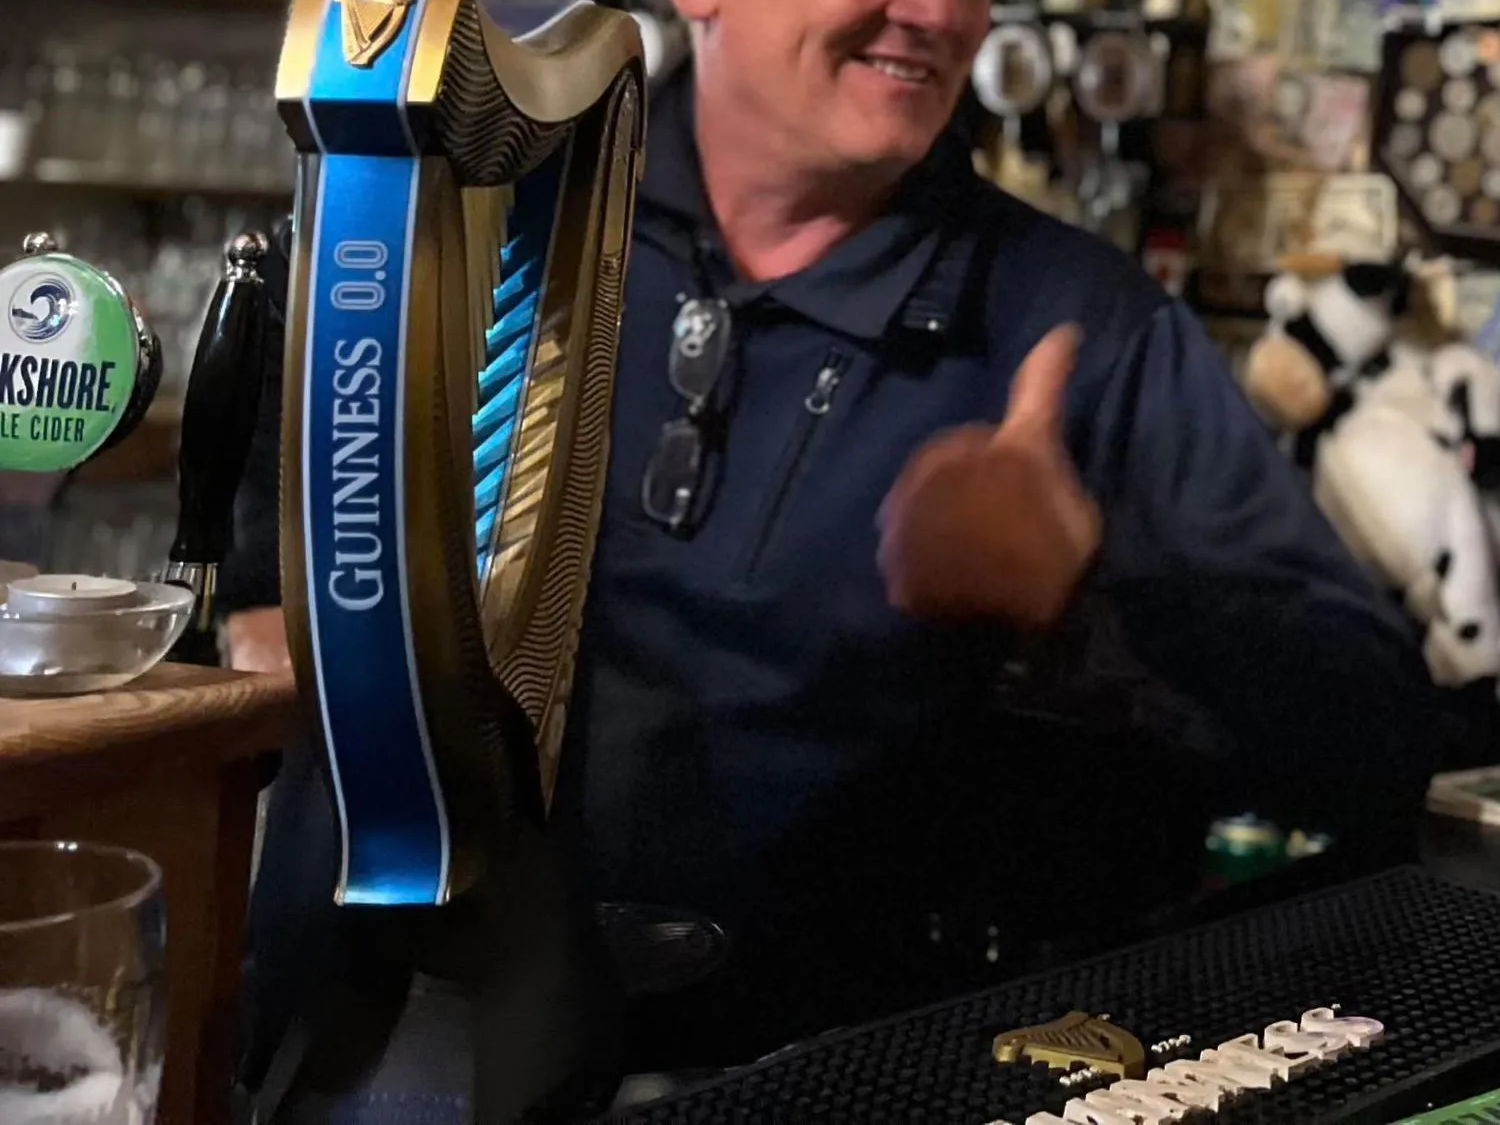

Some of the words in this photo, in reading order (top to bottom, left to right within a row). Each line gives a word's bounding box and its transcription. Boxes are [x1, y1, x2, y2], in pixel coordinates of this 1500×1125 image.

[330, 238, 390, 311] 0.0
[30, 415, 85, 442] CIDER
[328, 337, 384, 612] GUINNESS
